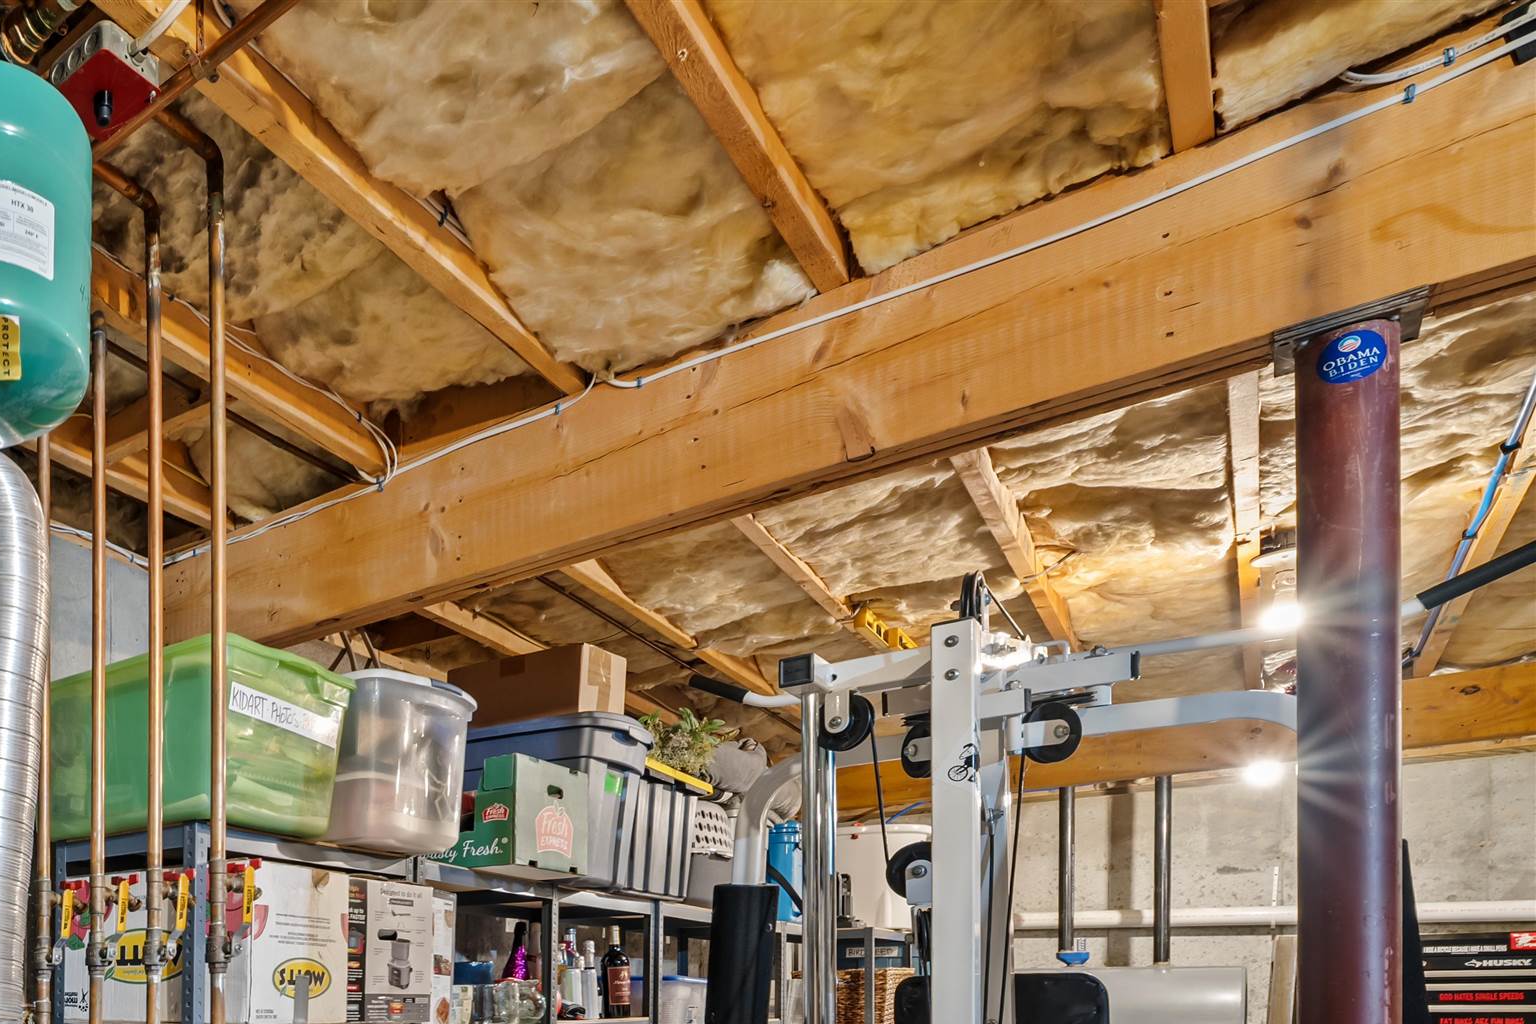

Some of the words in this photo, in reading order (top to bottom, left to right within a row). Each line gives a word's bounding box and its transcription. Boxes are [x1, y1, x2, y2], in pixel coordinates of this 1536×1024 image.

[1, 316, 11, 377] PROTECT
[1323, 346, 1380, 371] OBAMA
[1329, 355, 1378, 377] BIDEN
[541, 812, 569, 838] Fresh
[1482, 958, 1533, 967] HUSKY
[1454, 992, 1474, 1001] HATES
[1474, 992, 1498, 1001] SINGLE
[1499, 992, 1524, 1000] SPEEDS
[1439, 1017, 1453, 1024] FAT
[1474, 1017, 1489, 1024] ARE
[1490, 1017, 1504, 1024] FUN
